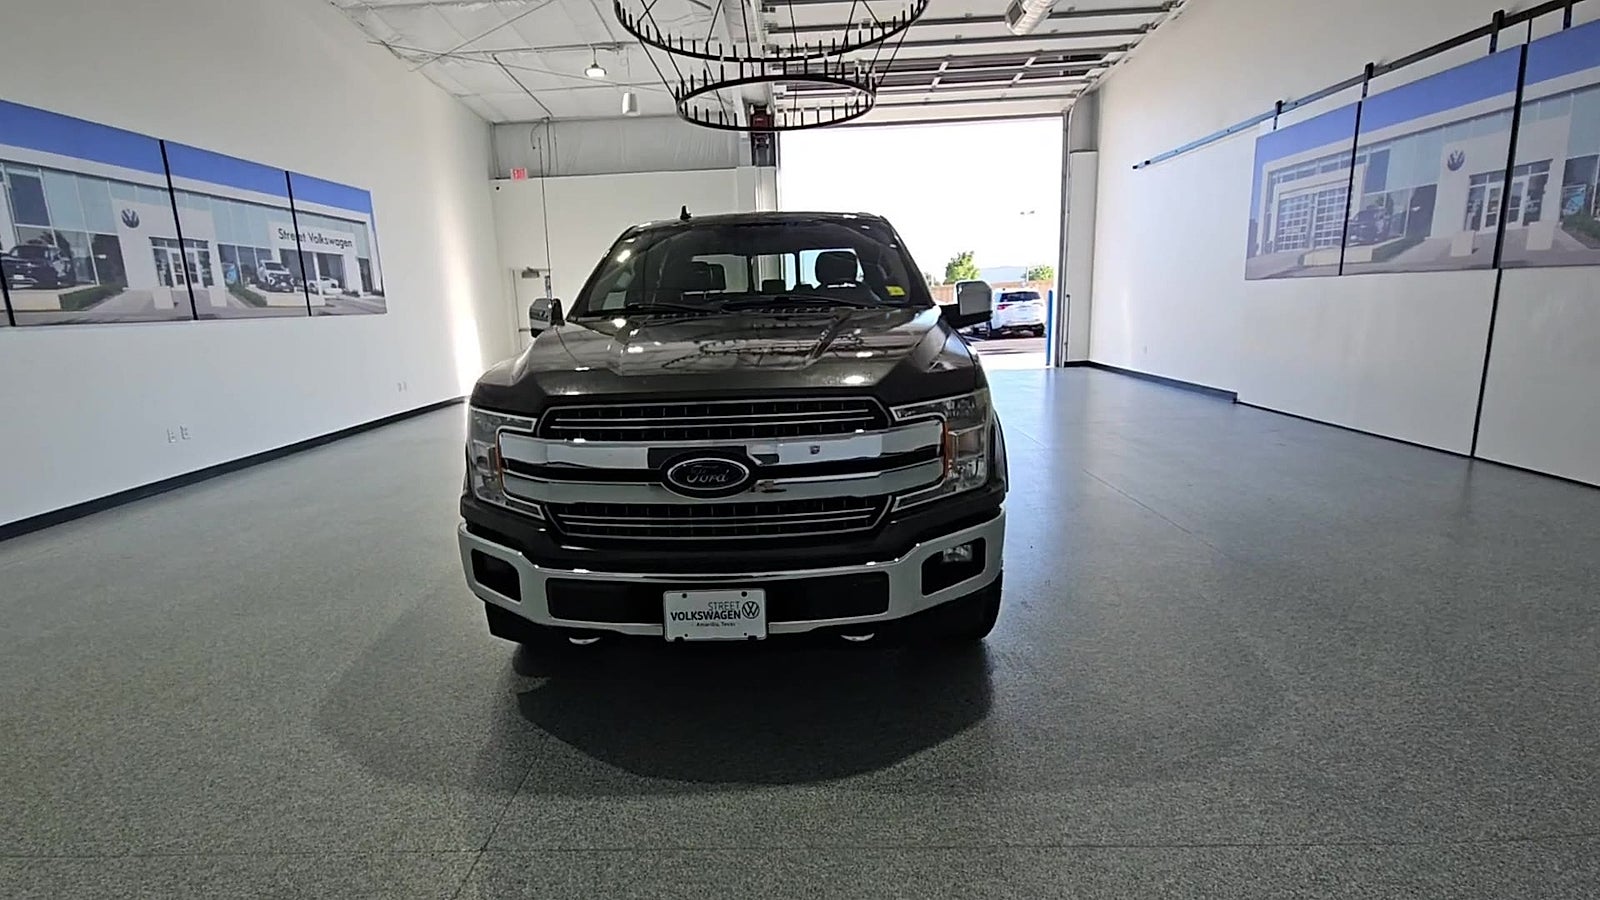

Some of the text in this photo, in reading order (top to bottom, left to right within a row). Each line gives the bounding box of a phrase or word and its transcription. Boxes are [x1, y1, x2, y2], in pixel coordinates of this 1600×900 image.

[307, 232, 353, 249] Volkswagen
[686, 464, 730, 483] Ford
[707, 601, 741, 611] STREET
[670, 611, 741, 621] VOLKSWAGEN
